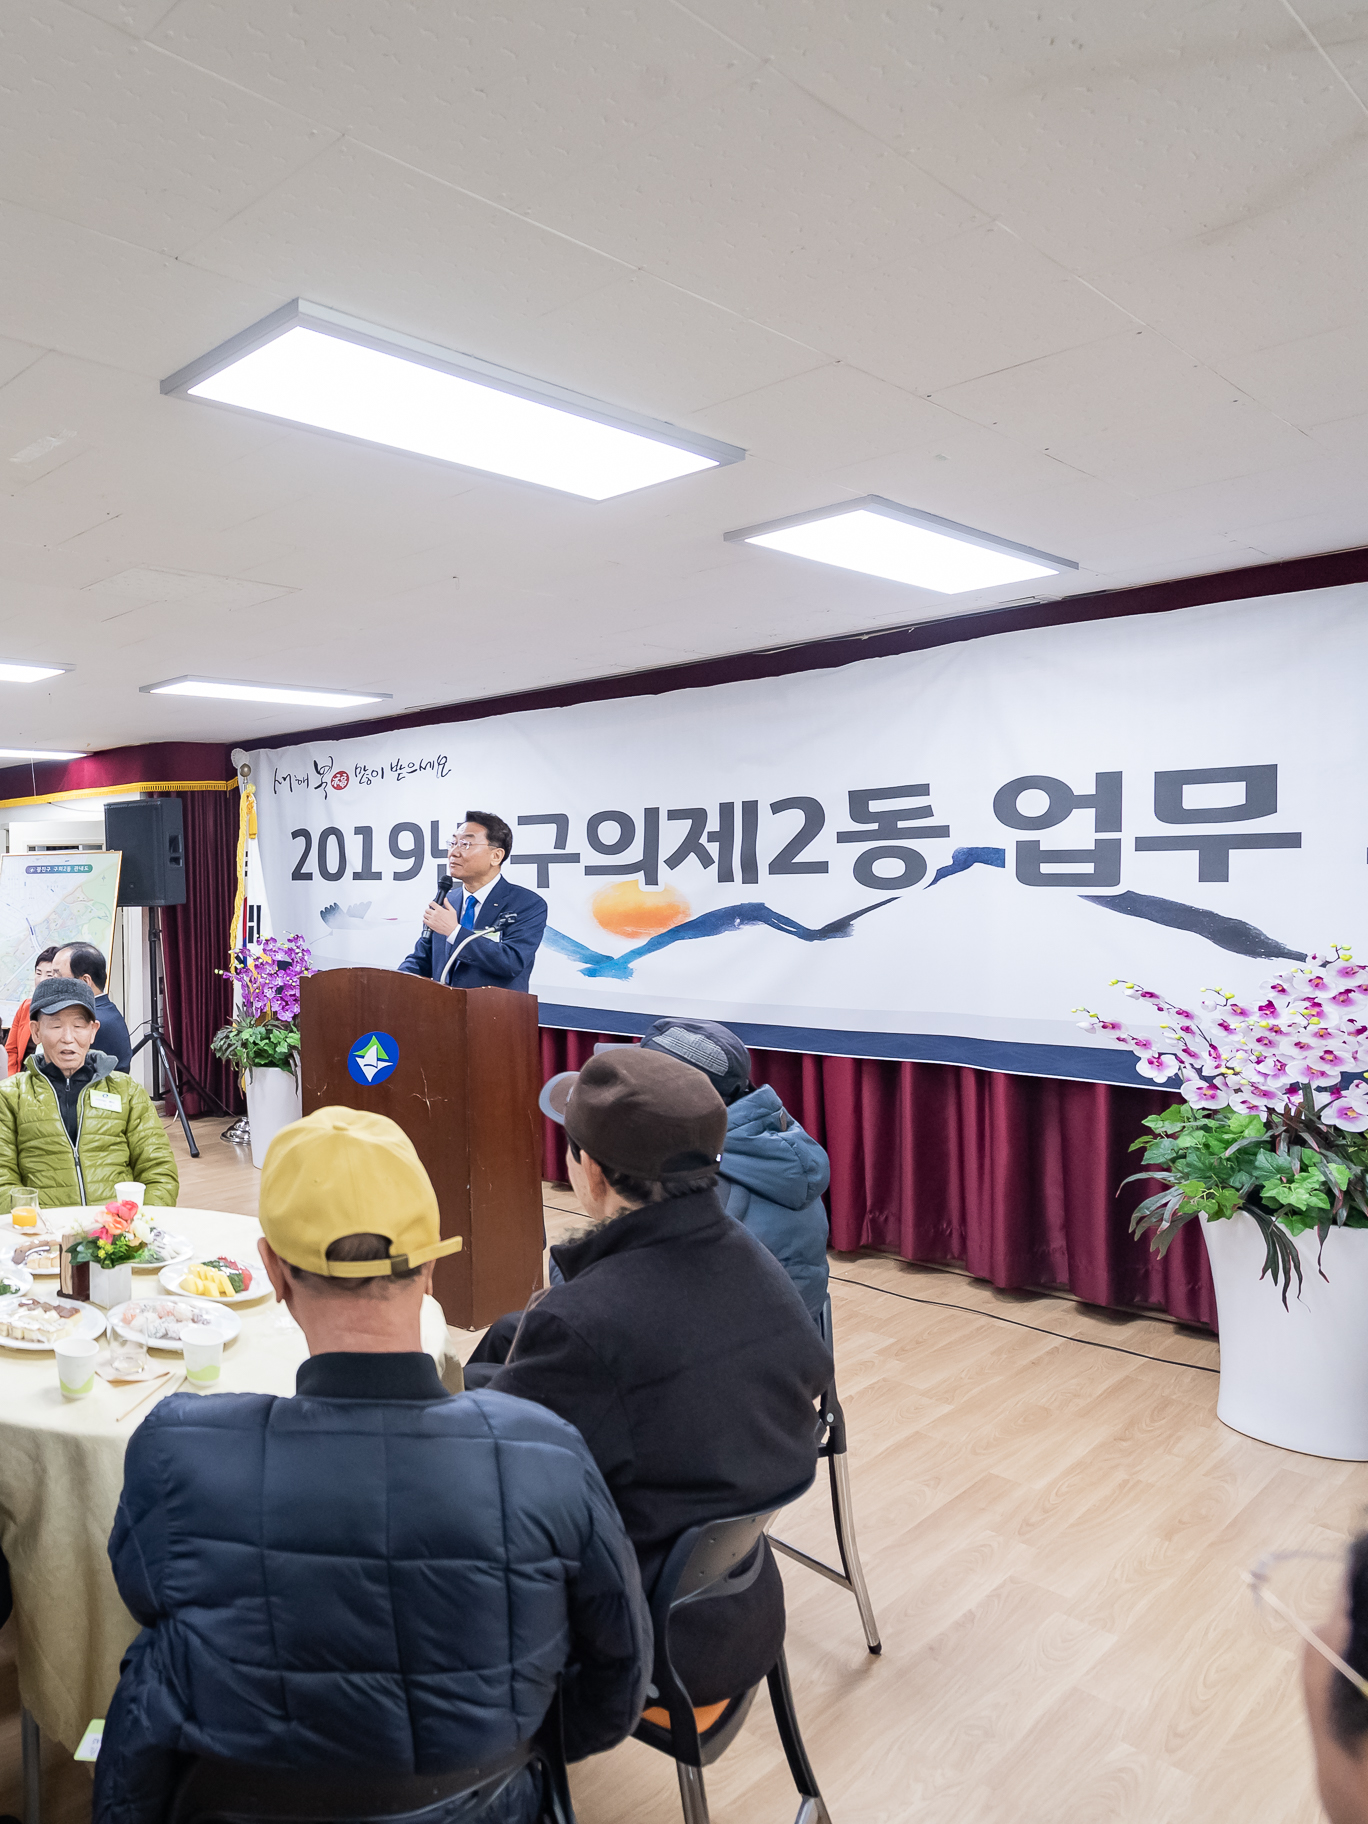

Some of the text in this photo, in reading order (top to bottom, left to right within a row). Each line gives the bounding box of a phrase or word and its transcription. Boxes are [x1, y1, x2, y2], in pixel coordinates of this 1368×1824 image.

[274, 768, 309, 794] 새해
[355, 755, 451, 785] 많이 받으세요
[510, 783, 950, 890] 구의제2동
[993, 764, 1302, 887] 업무
